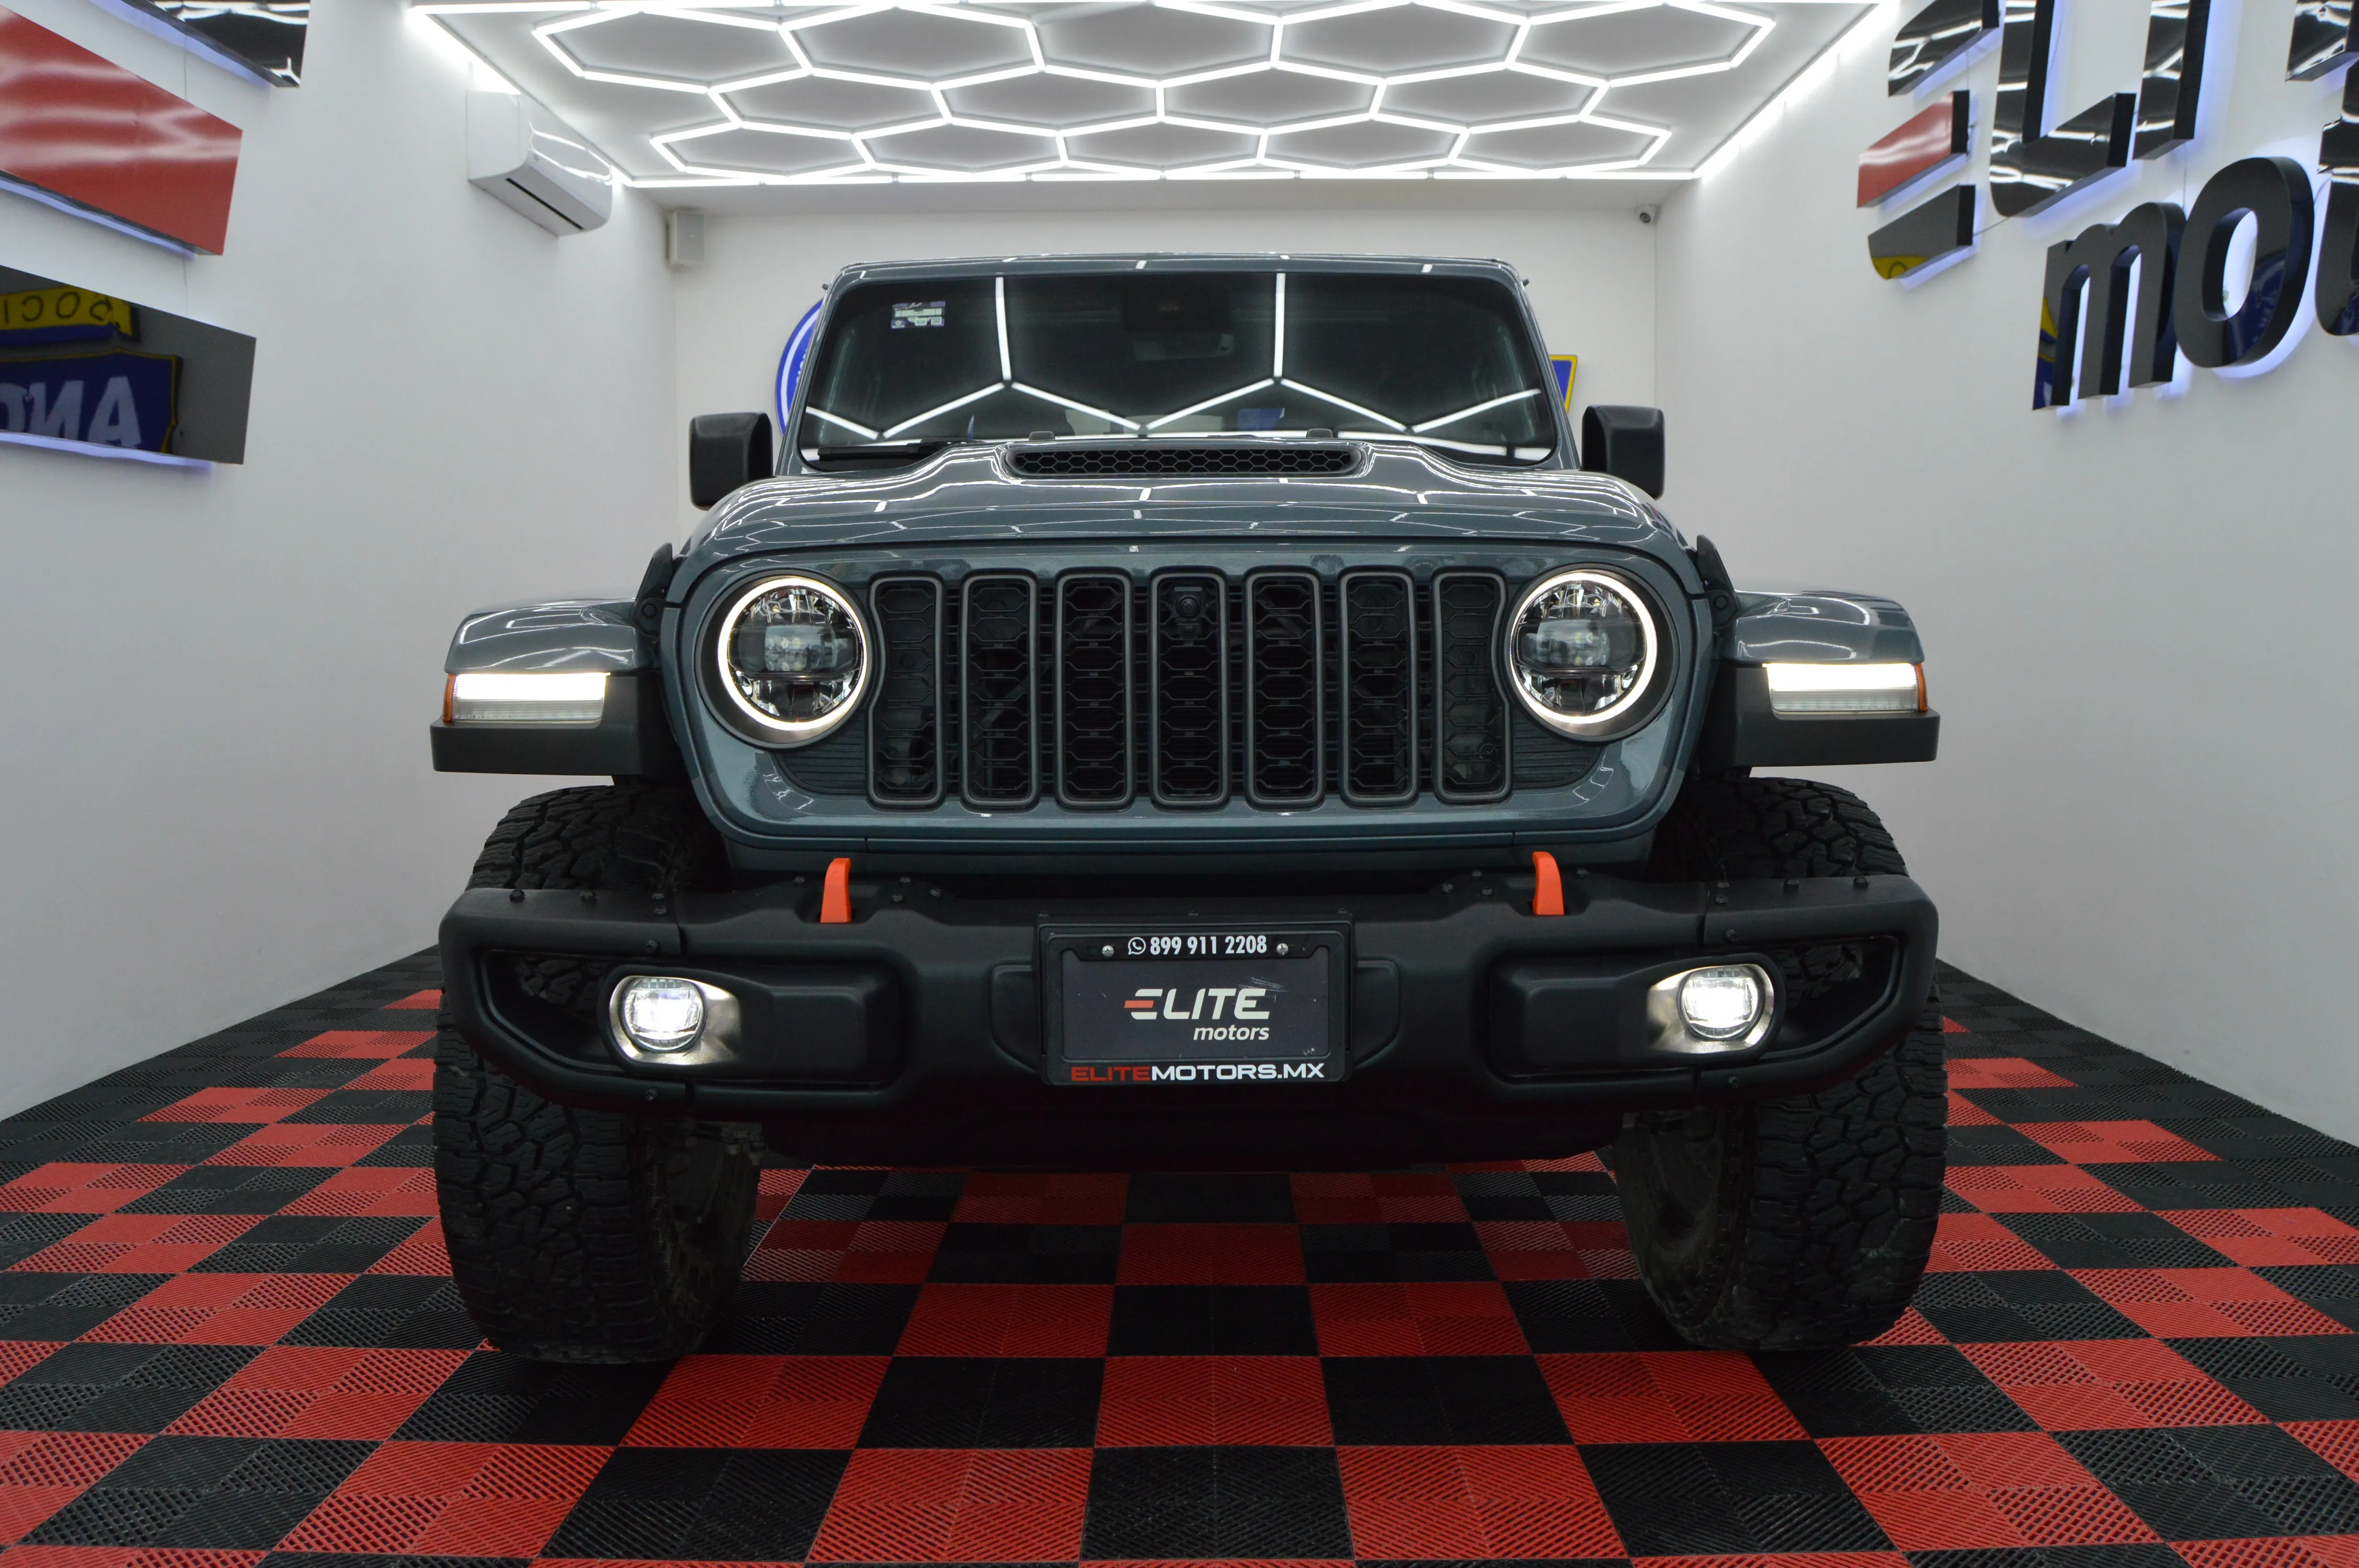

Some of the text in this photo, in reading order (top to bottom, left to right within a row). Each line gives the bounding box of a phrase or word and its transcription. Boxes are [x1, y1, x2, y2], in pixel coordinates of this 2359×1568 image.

[1150, 936, 1267, 954] 899 911 2208
[1124, 988, 1269, 1020] ELITE
[1194, 1024, 1269, 1040] motors
[1072, 1063, 1324, 1081] ELITEMOTORS.MX
